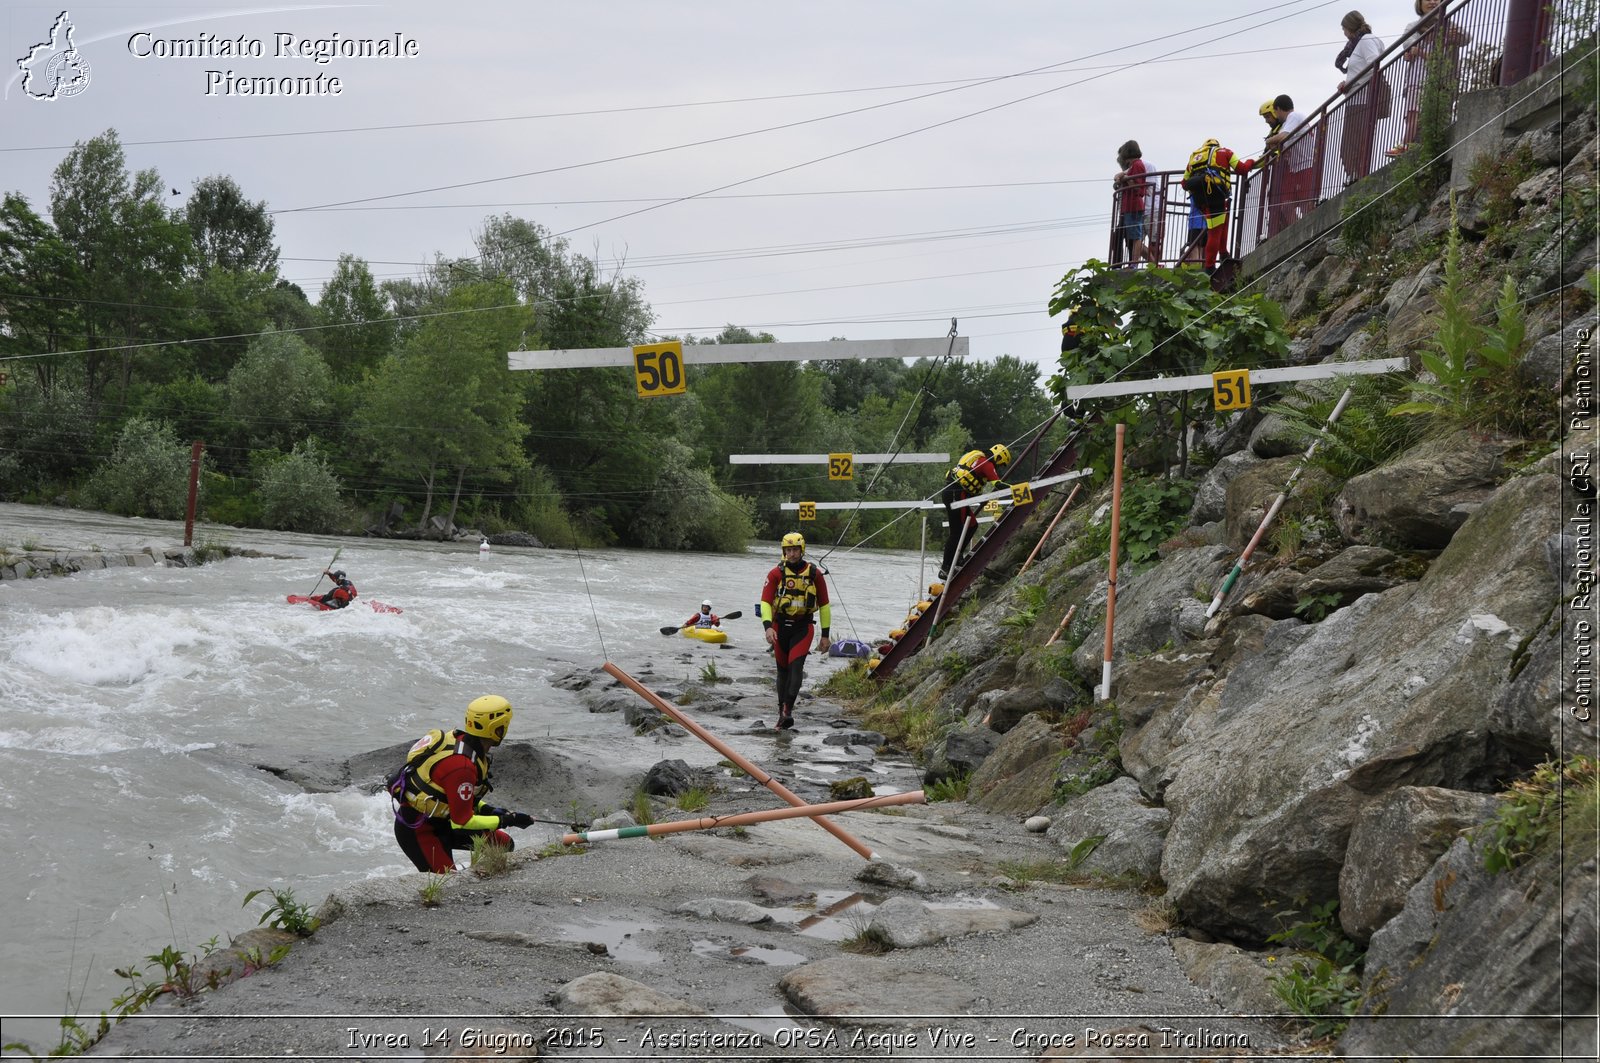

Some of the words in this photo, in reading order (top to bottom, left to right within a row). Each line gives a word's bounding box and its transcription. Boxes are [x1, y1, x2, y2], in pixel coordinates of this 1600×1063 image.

[636, 351, 681, 391] 50
[1216, 376, 1246, 406] 51
[830, 458, 851, 477] 52
[1012, 486, 1031, 504] 54
[800, 505, 815, 518] 55
